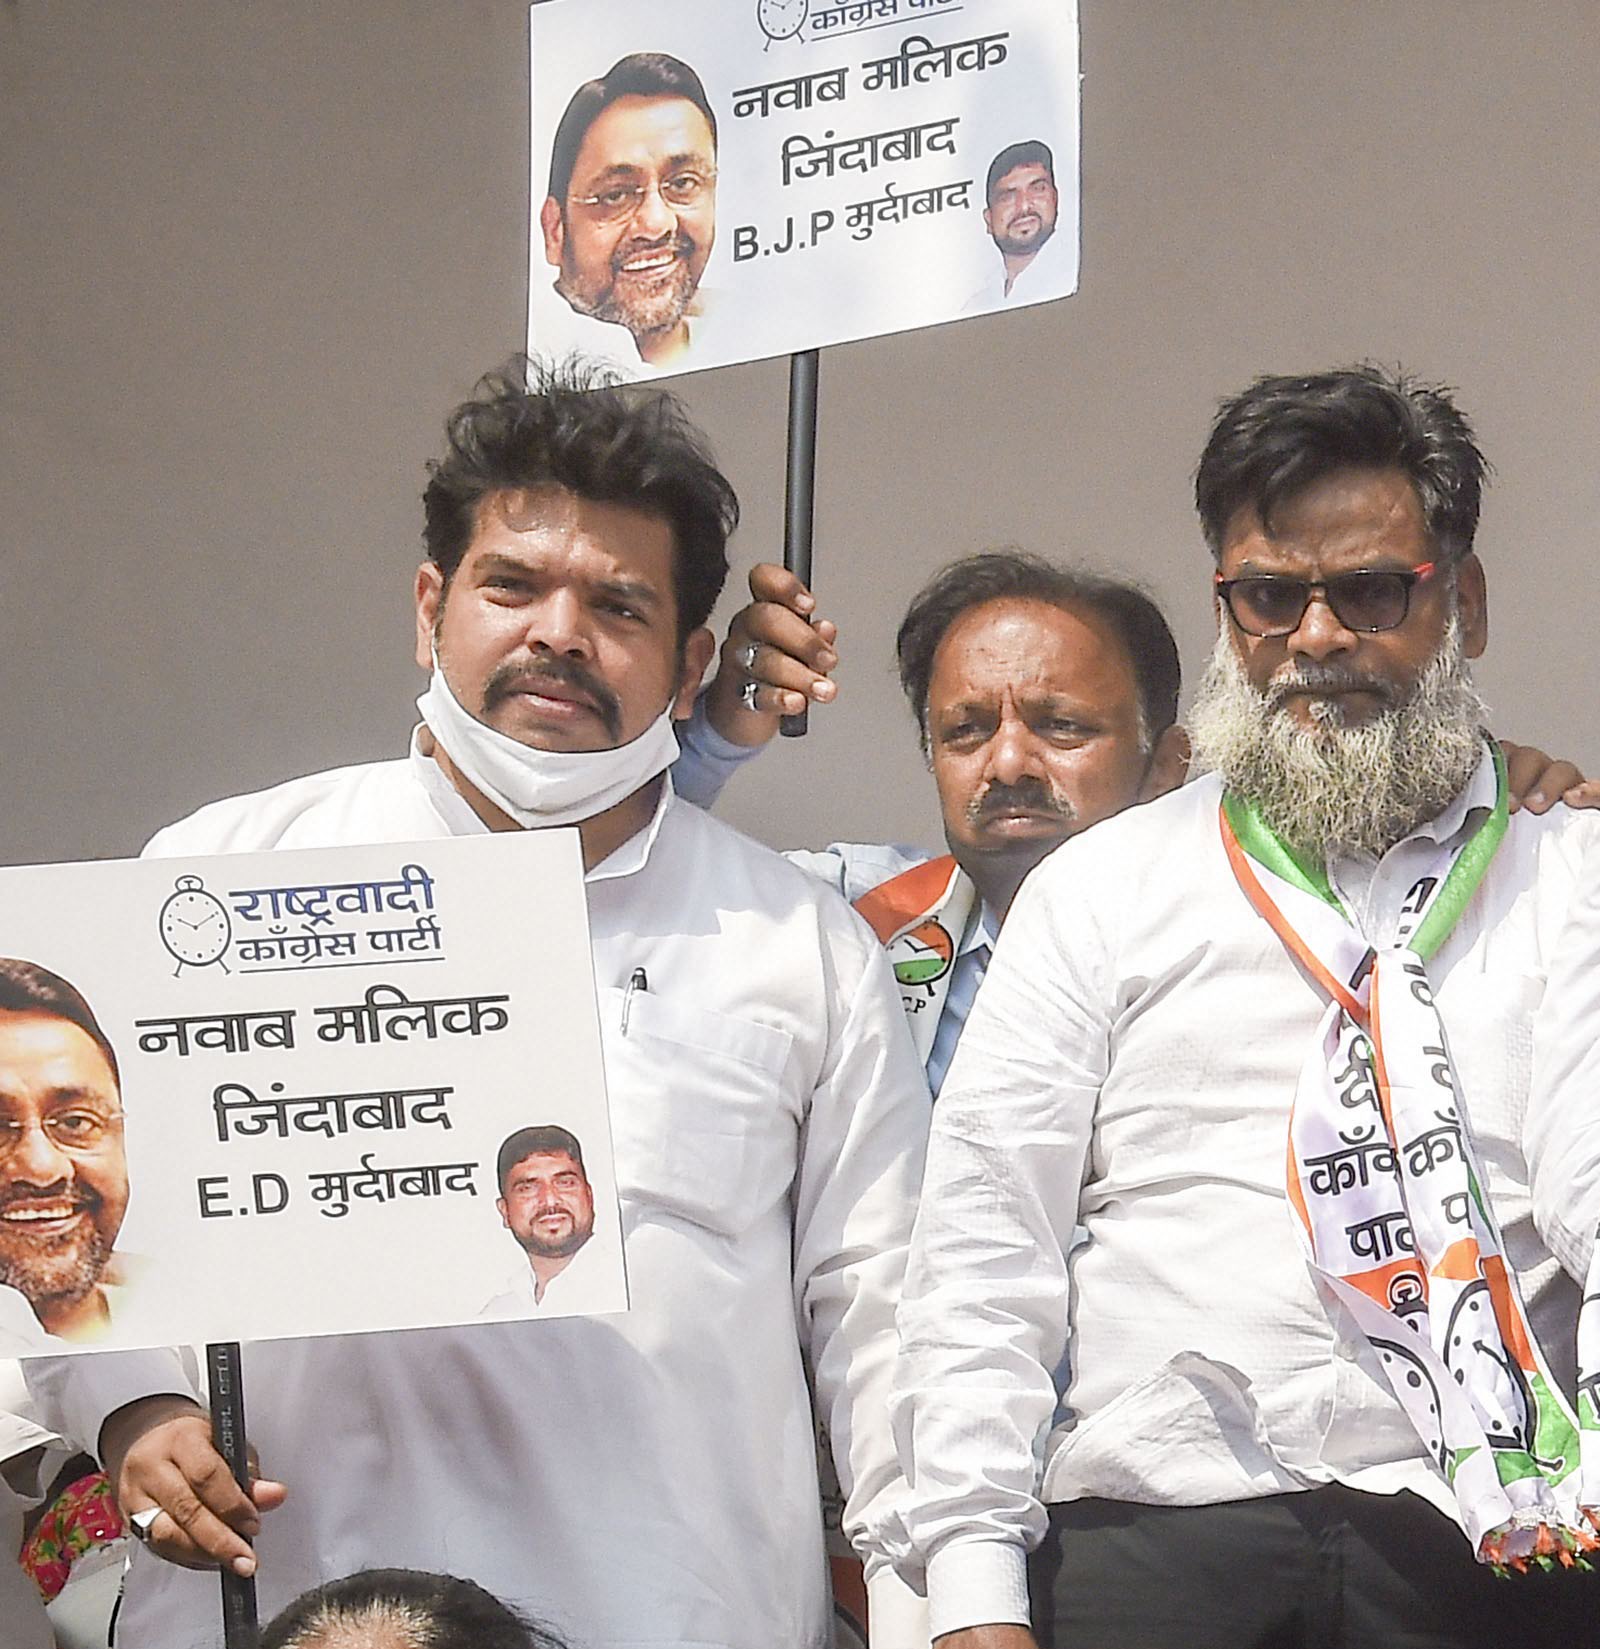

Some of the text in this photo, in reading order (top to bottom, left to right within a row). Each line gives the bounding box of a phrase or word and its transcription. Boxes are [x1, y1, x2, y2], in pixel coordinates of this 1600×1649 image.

[732, 32, 1009, 117] नवाब मलिक
[782, 118, 960, 186] जिंदाबाद
[734, 180, 973, 262] B.J.P मुर्दाबाद
[366, 915, 441, 952] पार्टी
[135, 985, 509, 1056] नवाब मलिक
[213, 1083, 454, 1141] जिंदाबाद
[198, 1154, 478, 1218] E.D मुर्दाबाद
